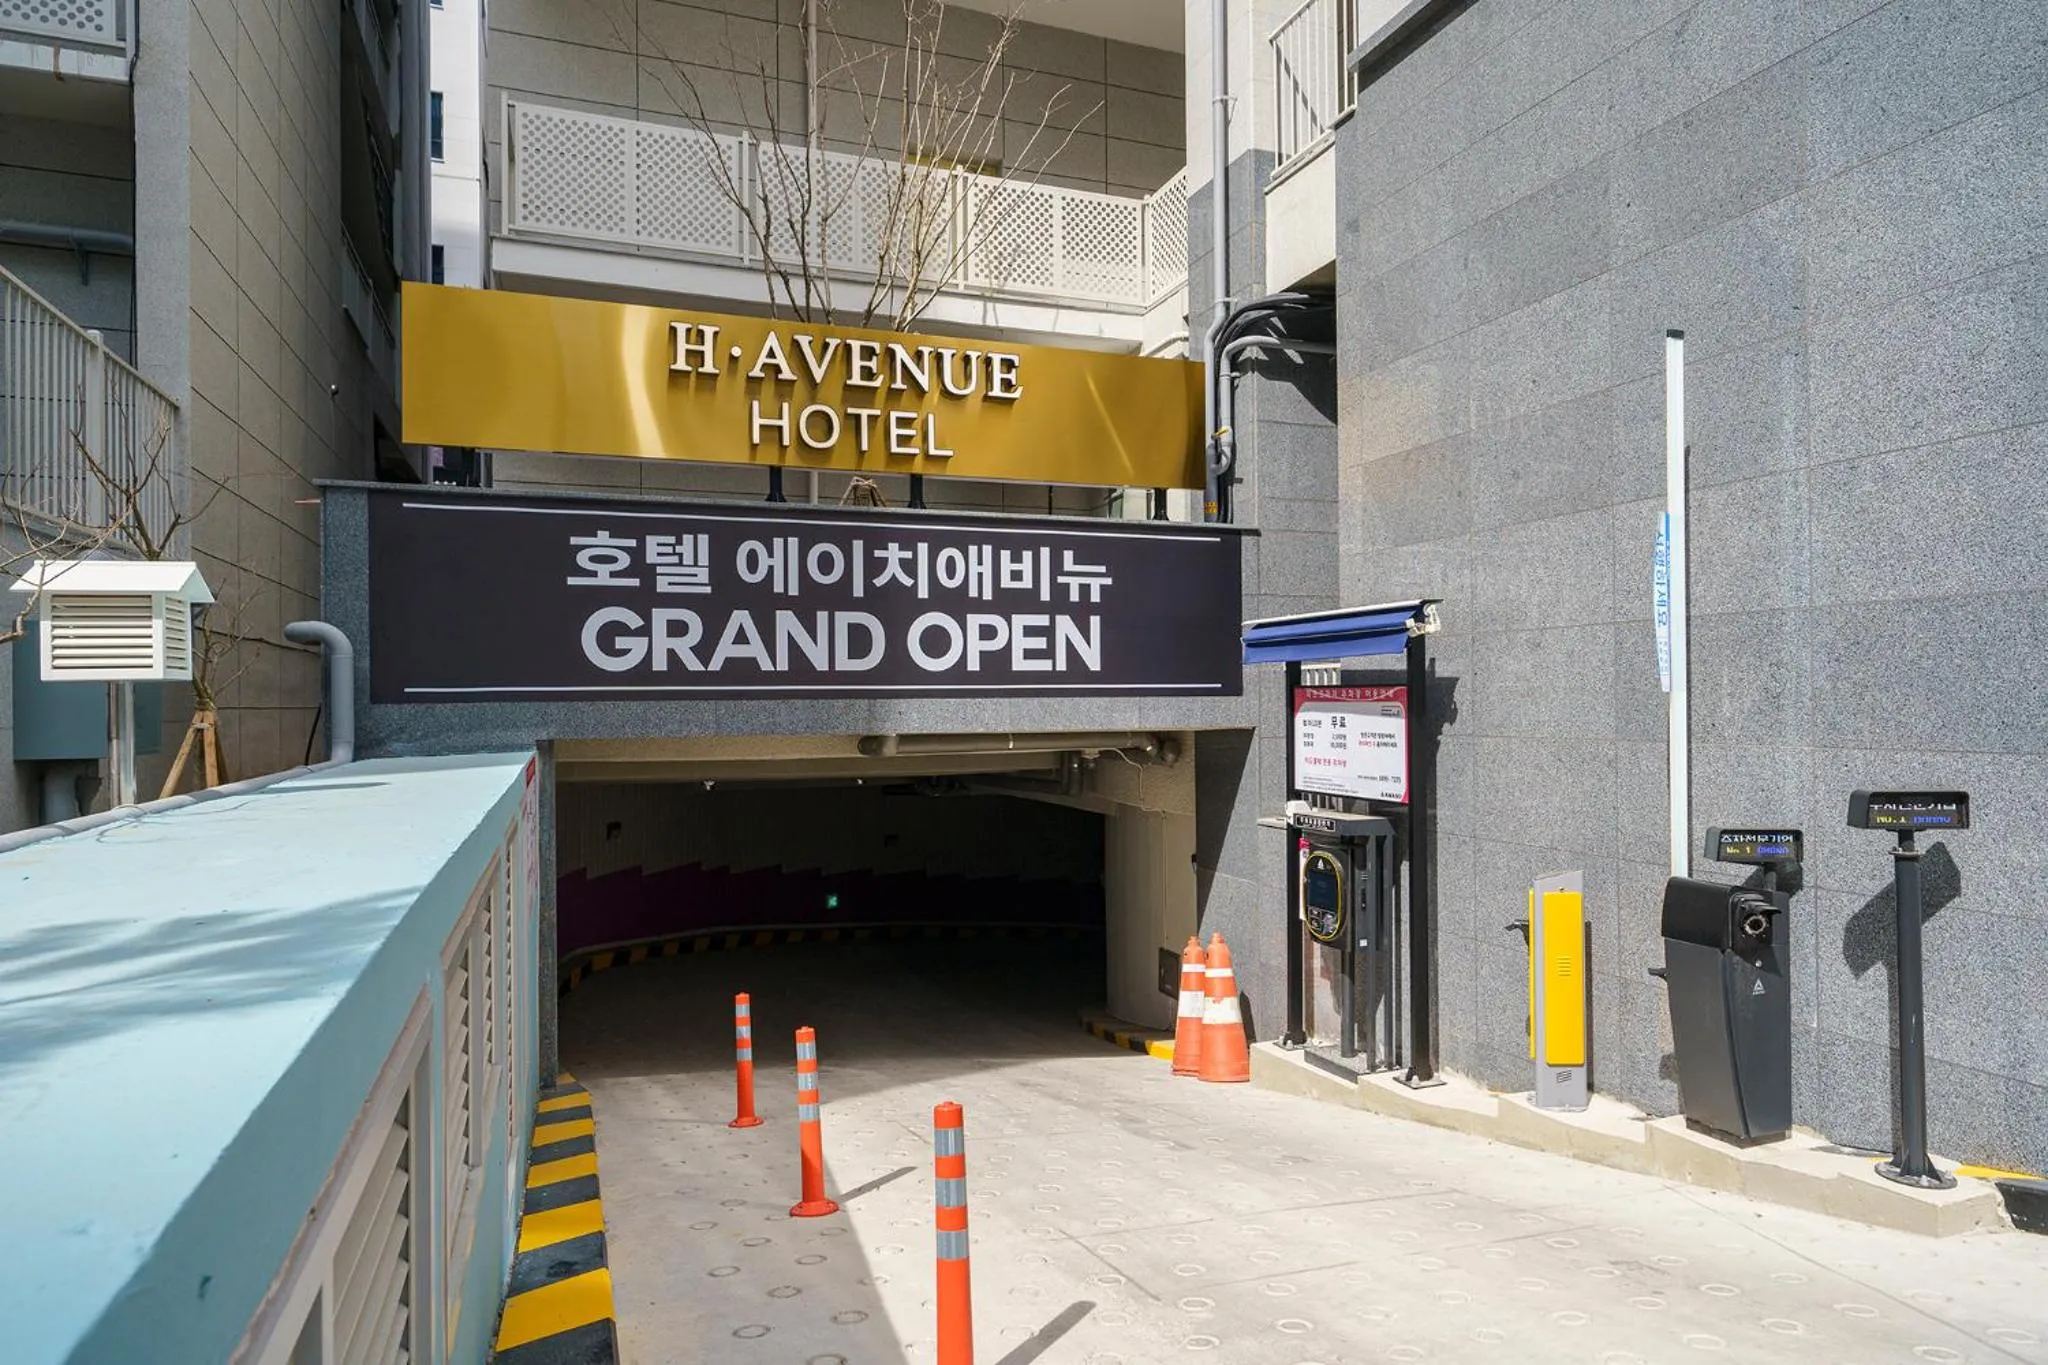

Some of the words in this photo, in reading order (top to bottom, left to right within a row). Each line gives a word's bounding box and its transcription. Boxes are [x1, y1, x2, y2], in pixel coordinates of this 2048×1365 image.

[751, 399, 954, 457] HOTEL
[566, 530, 711, 594] 호텔
[735, 536, 1113, 603] 에이치애비뉴
[580, 605, 886, 672] GRAND
[906, 611, 1101, 672] OPEN
